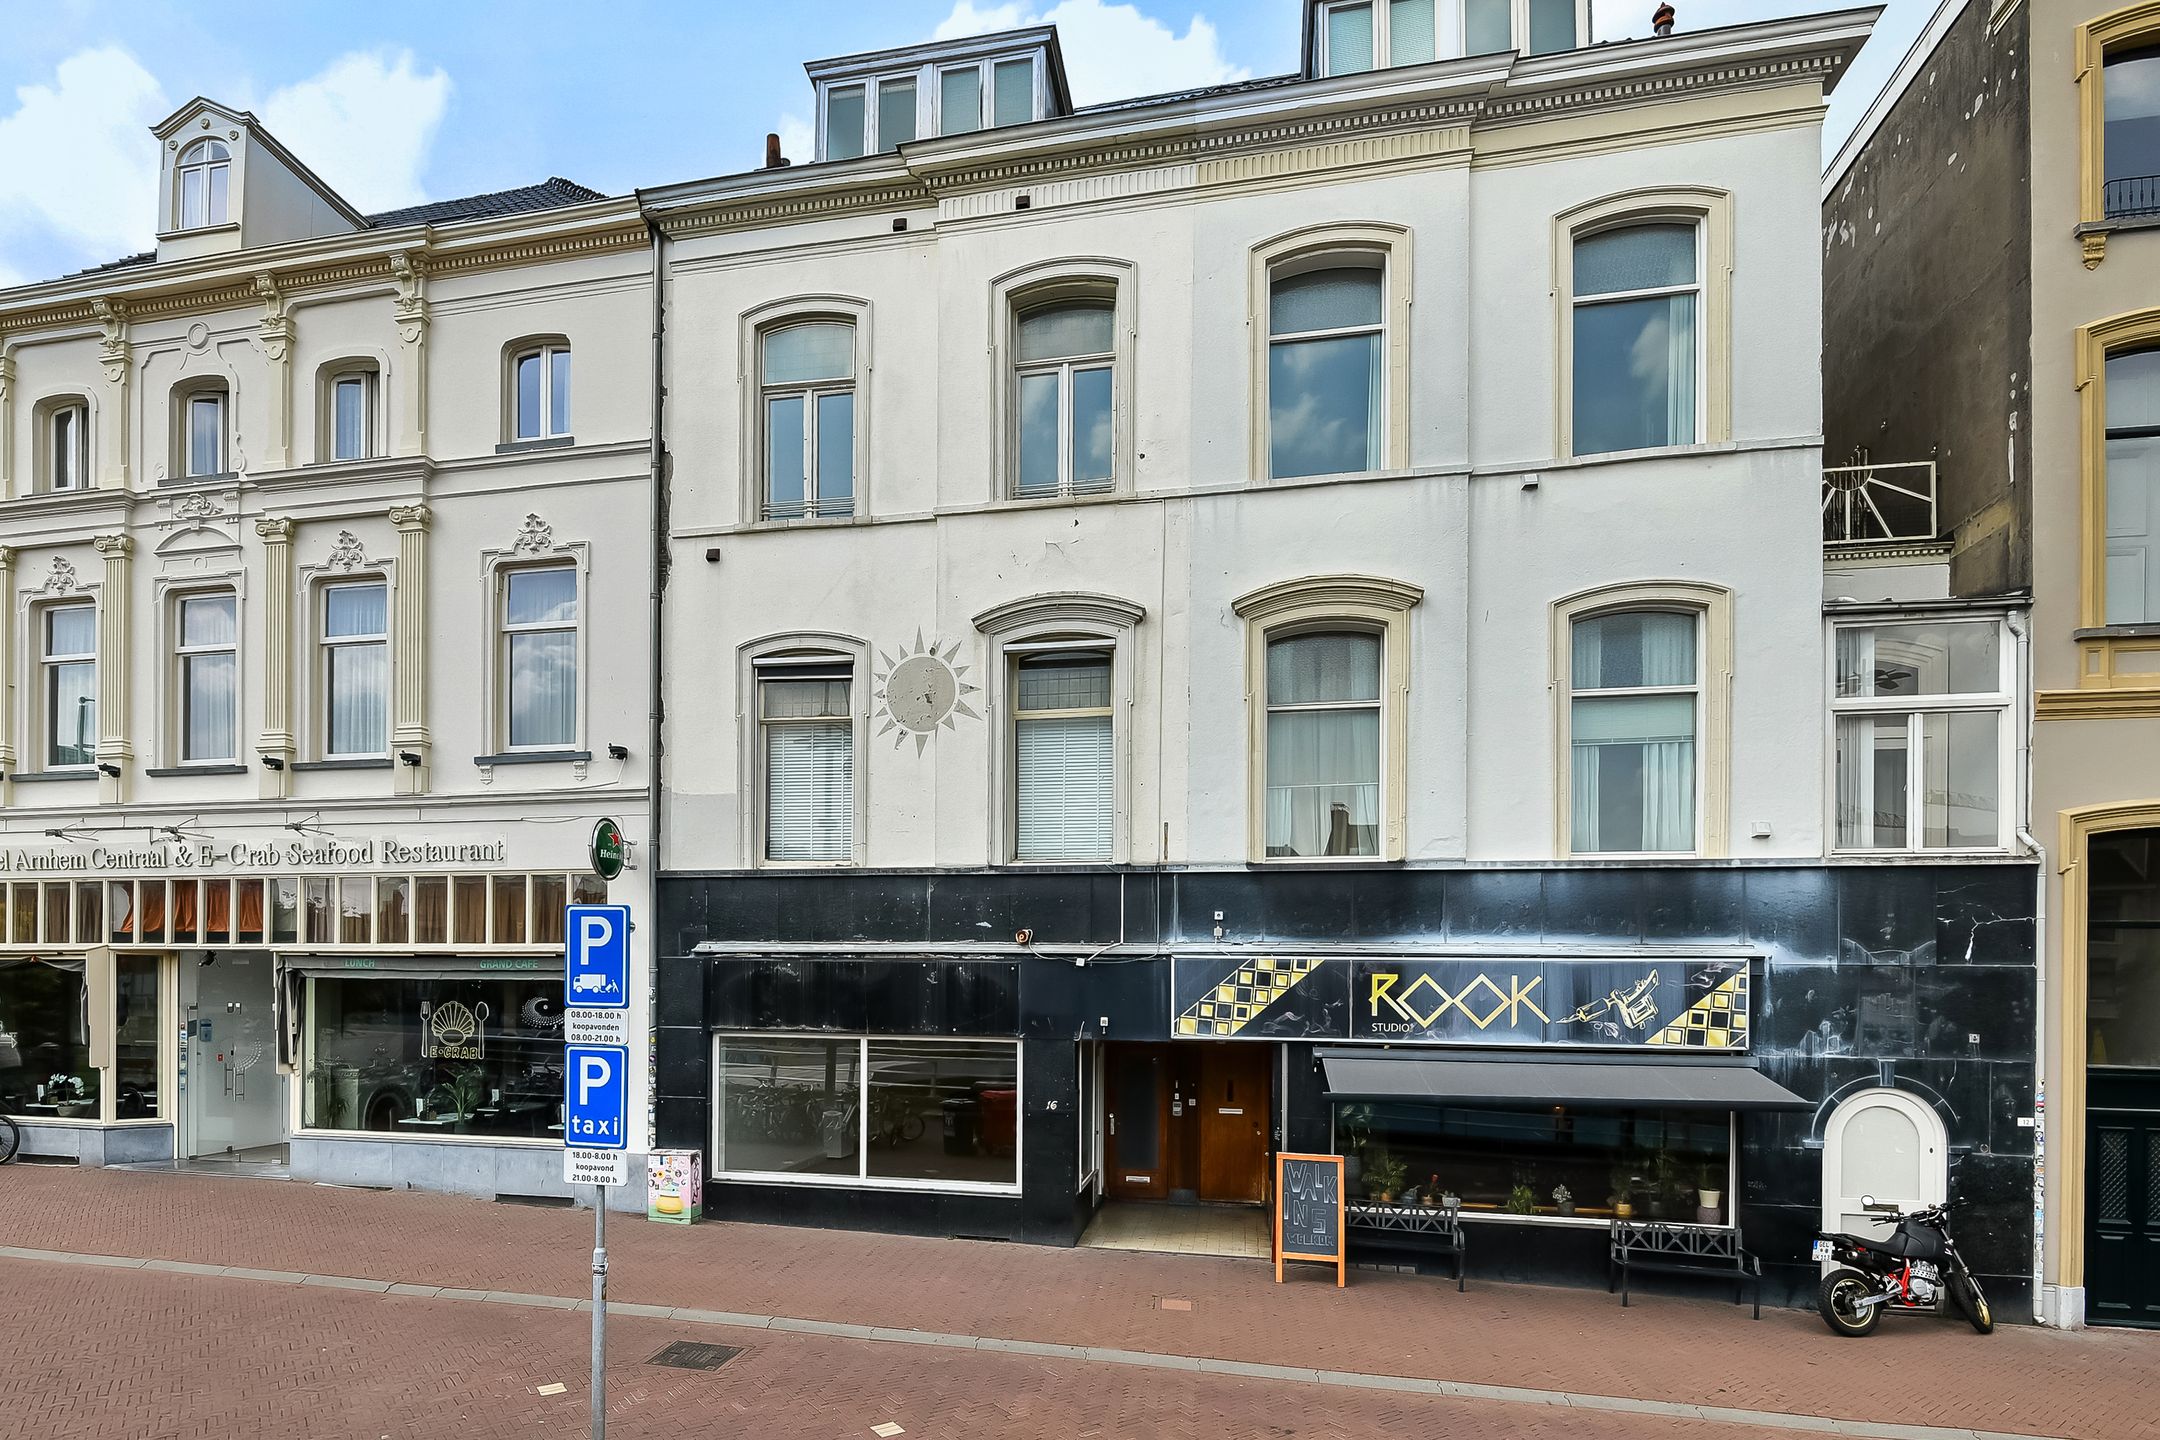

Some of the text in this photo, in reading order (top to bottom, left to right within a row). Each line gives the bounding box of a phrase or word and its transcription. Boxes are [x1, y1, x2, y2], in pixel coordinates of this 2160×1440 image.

[16, 849, 86, 870] Arnhem
[92, 846, 167, 869] Centraal
[174, 845, 193, 867] &
[199, 843, 280, 867] E-Crab
[287, 840, 374, 865] Seafood
[380, 840, 504, 863] Restaurant
[581, 916, 612, 965] P
[344, 958, 376, 968] LUNCH
[480, 959, 512, 969] GRAND
[1369, 972, 1551, 1030] ROOK
[570, 1010, 622, 1020] 08.00-18.00 h
[572, 1022, 620, 1031] koopavonden
[1371, 1022, 1410, 1032] STUDIO
[570, 1033, 621, 1043] 08.00-21.00 h
[579, 1056, 612, 1105] P
[1046, 1100, 1058, 1110] 16
[571, 1114, 619, 1136] taxi
[572, 1151, 618, 1161] 18.00-8.00 h
[575, 1162, 614, 1172] koopavond
[572, 1173, 618, 1184] 21.00-8.00 h
[1286, 1163, 1338, 1204] WALK
